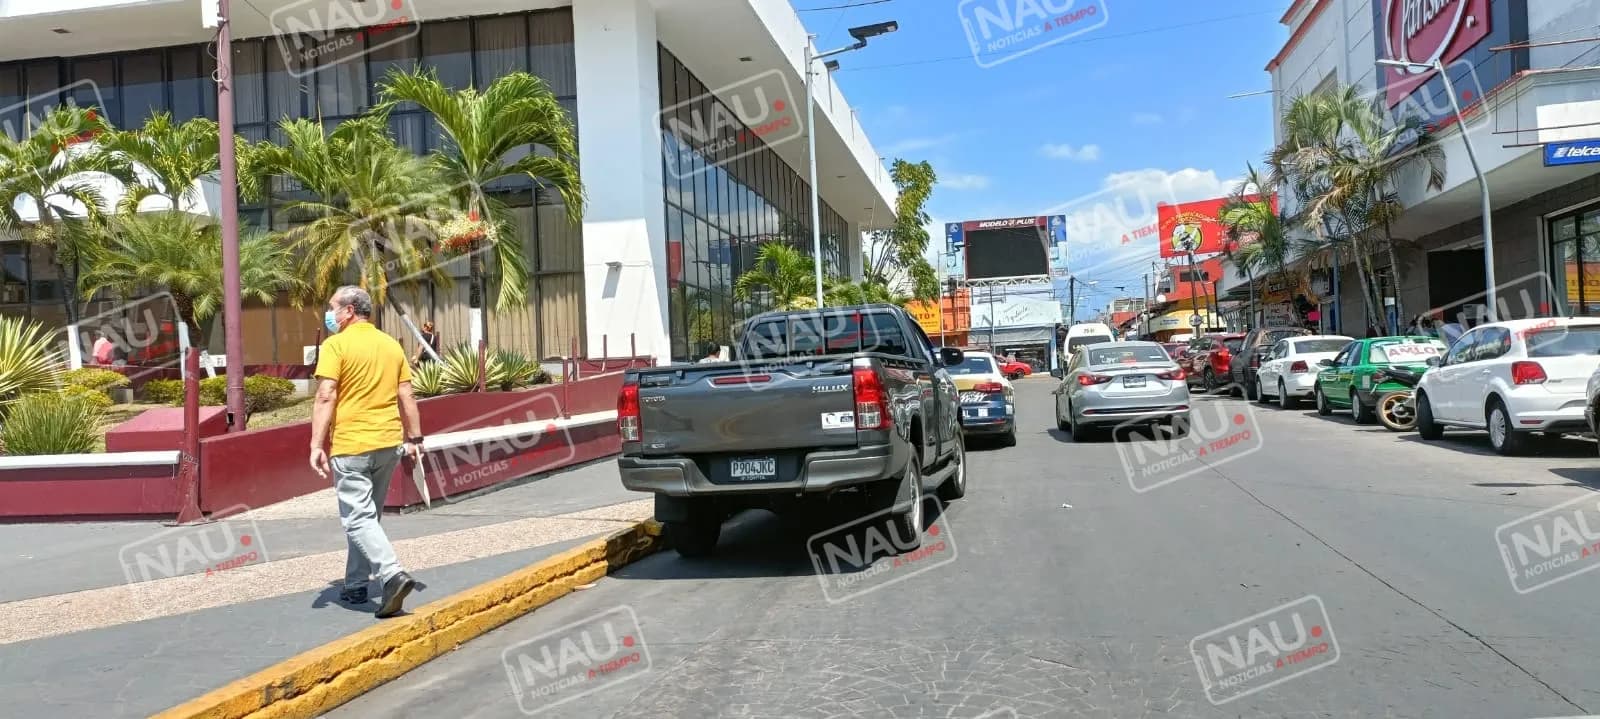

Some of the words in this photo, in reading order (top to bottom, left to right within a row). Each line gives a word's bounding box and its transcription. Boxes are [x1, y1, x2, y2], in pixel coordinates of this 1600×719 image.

[1389, 346, 1436, 356] AMLO
[812, 384, 848, 393] HILUX
[733, 461, 774, 475] P904JKC
